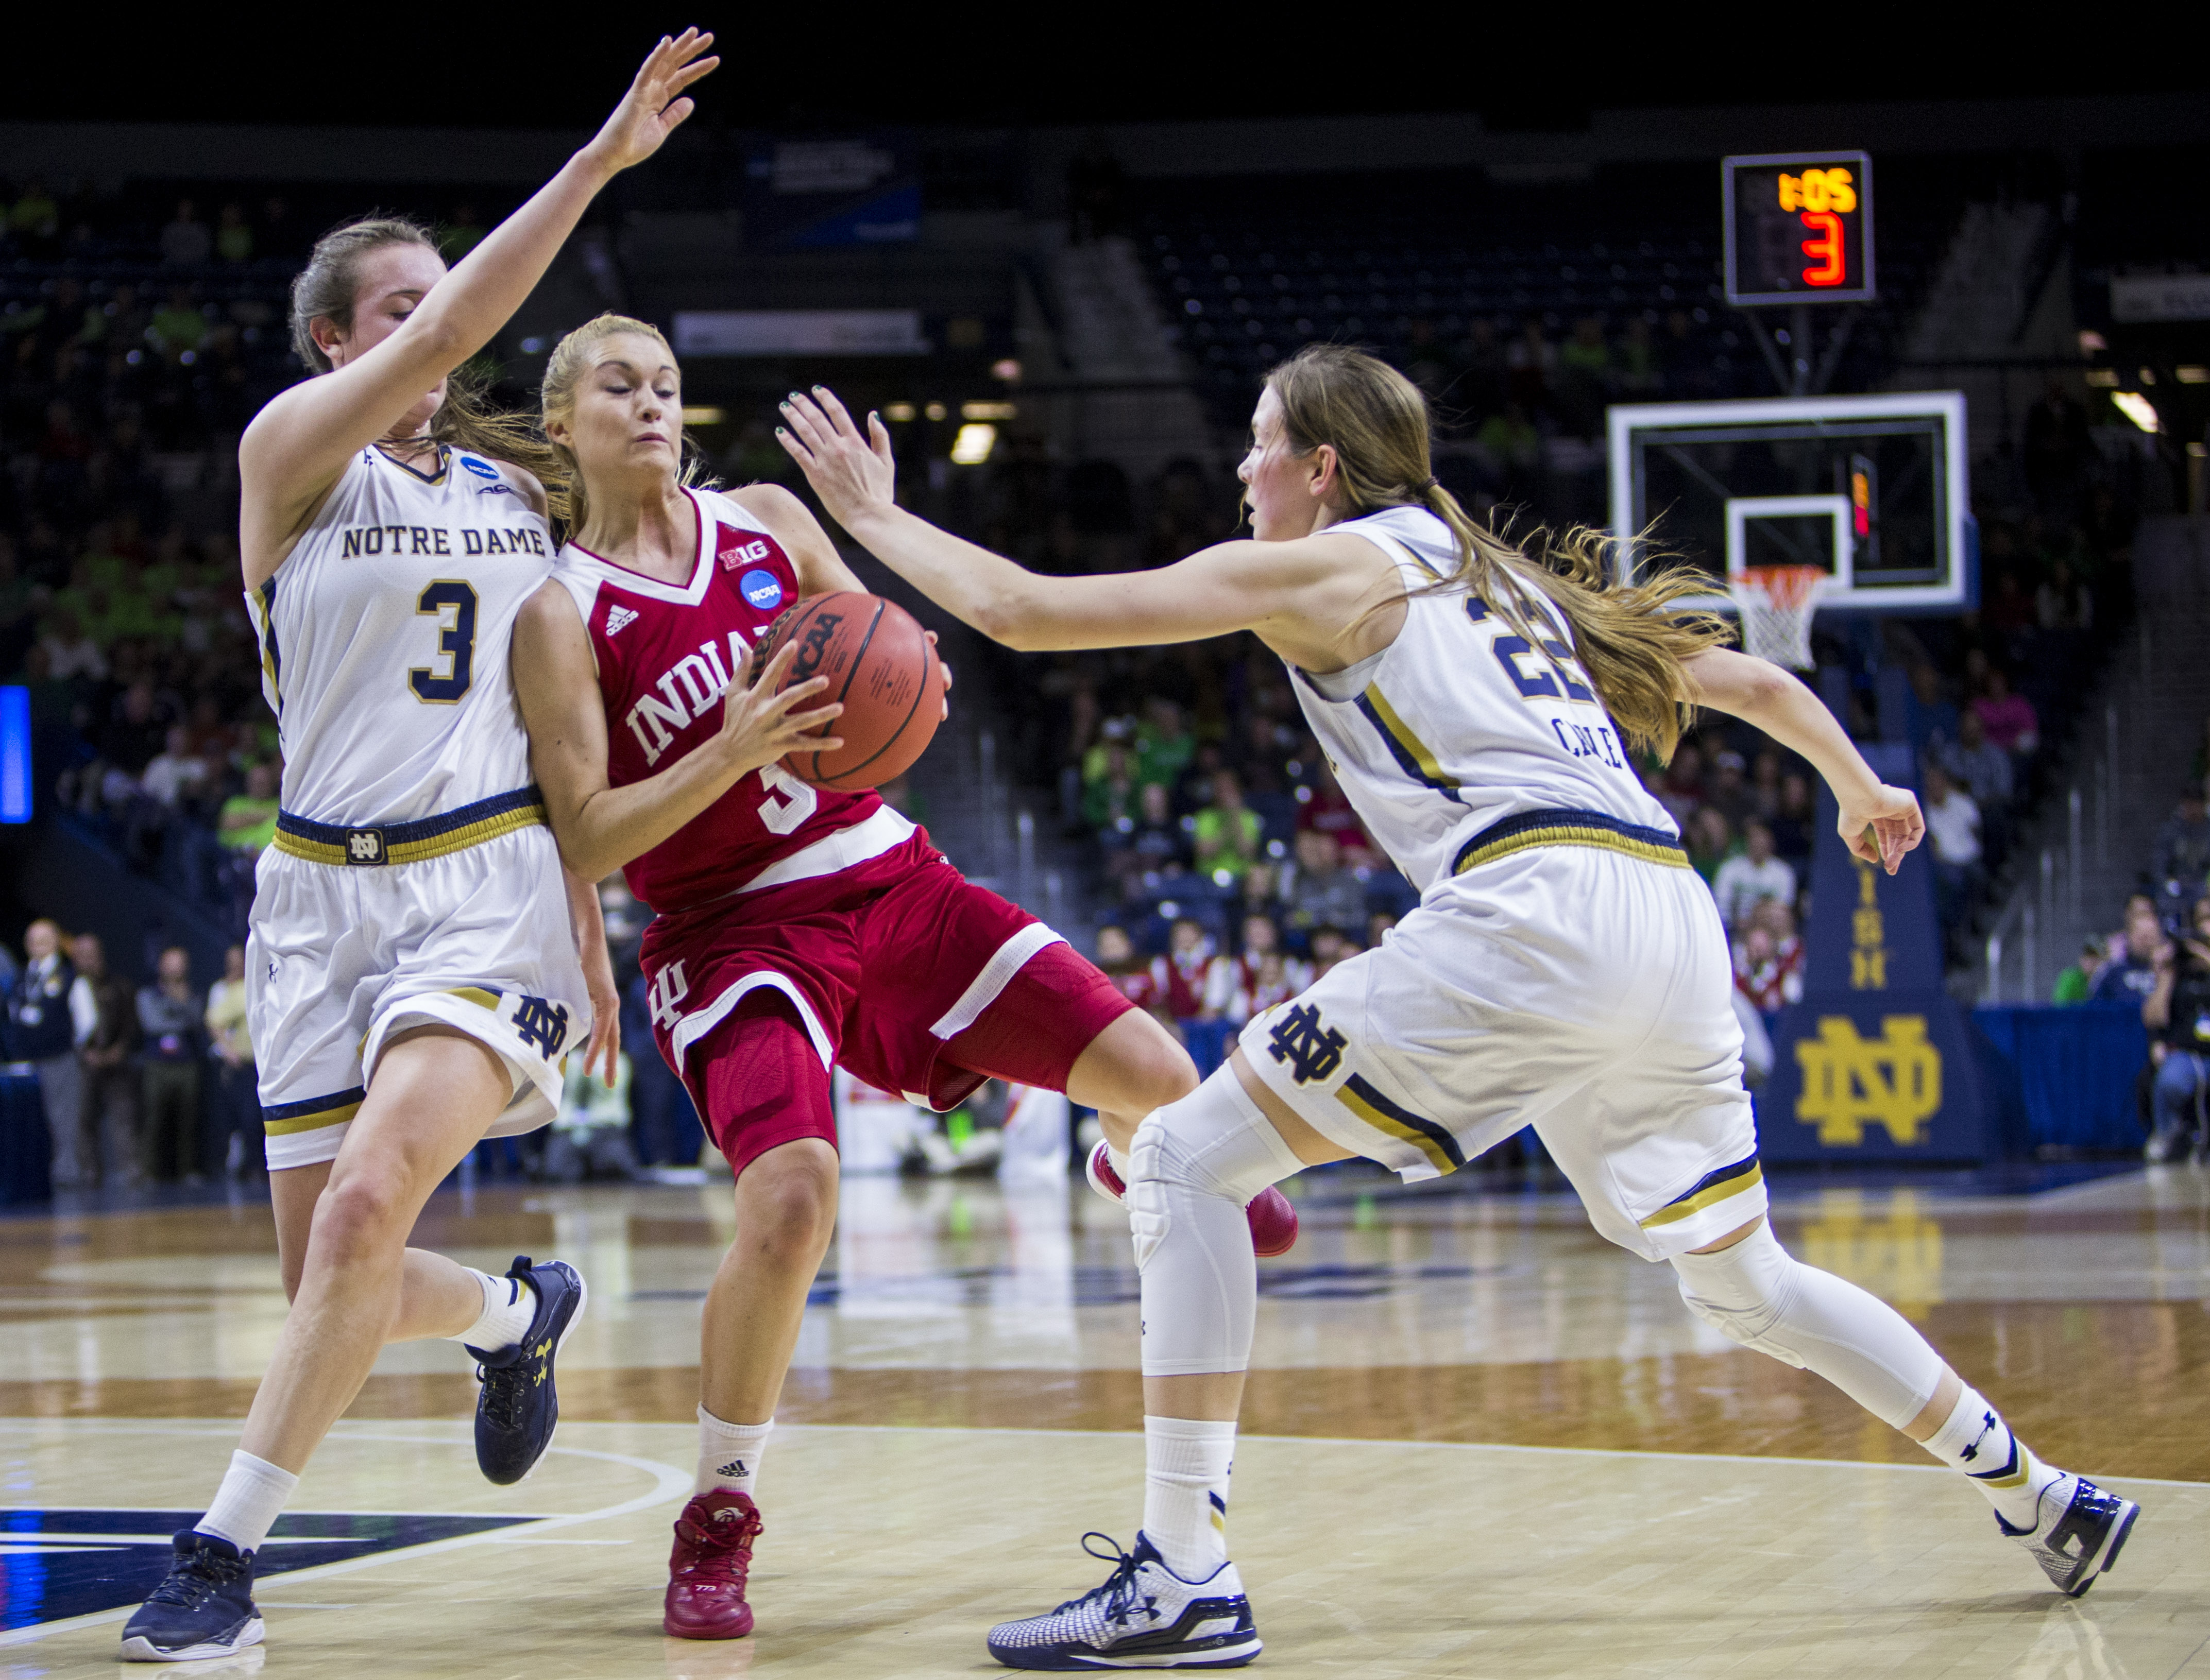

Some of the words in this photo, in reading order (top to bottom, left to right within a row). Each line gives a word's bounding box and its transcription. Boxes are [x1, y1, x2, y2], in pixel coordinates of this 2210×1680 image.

[1801, 212, 1845, 286] 3
[341, 525, 452, 560] NOTRE
[462, 528, 546, 558] DAME
[749, 584, 781, 602] NCAA
[407, 578, 480, 705] 3
[625, 625, 769, 767] INDIA
[717, 1468, 750, 1478] adidas
